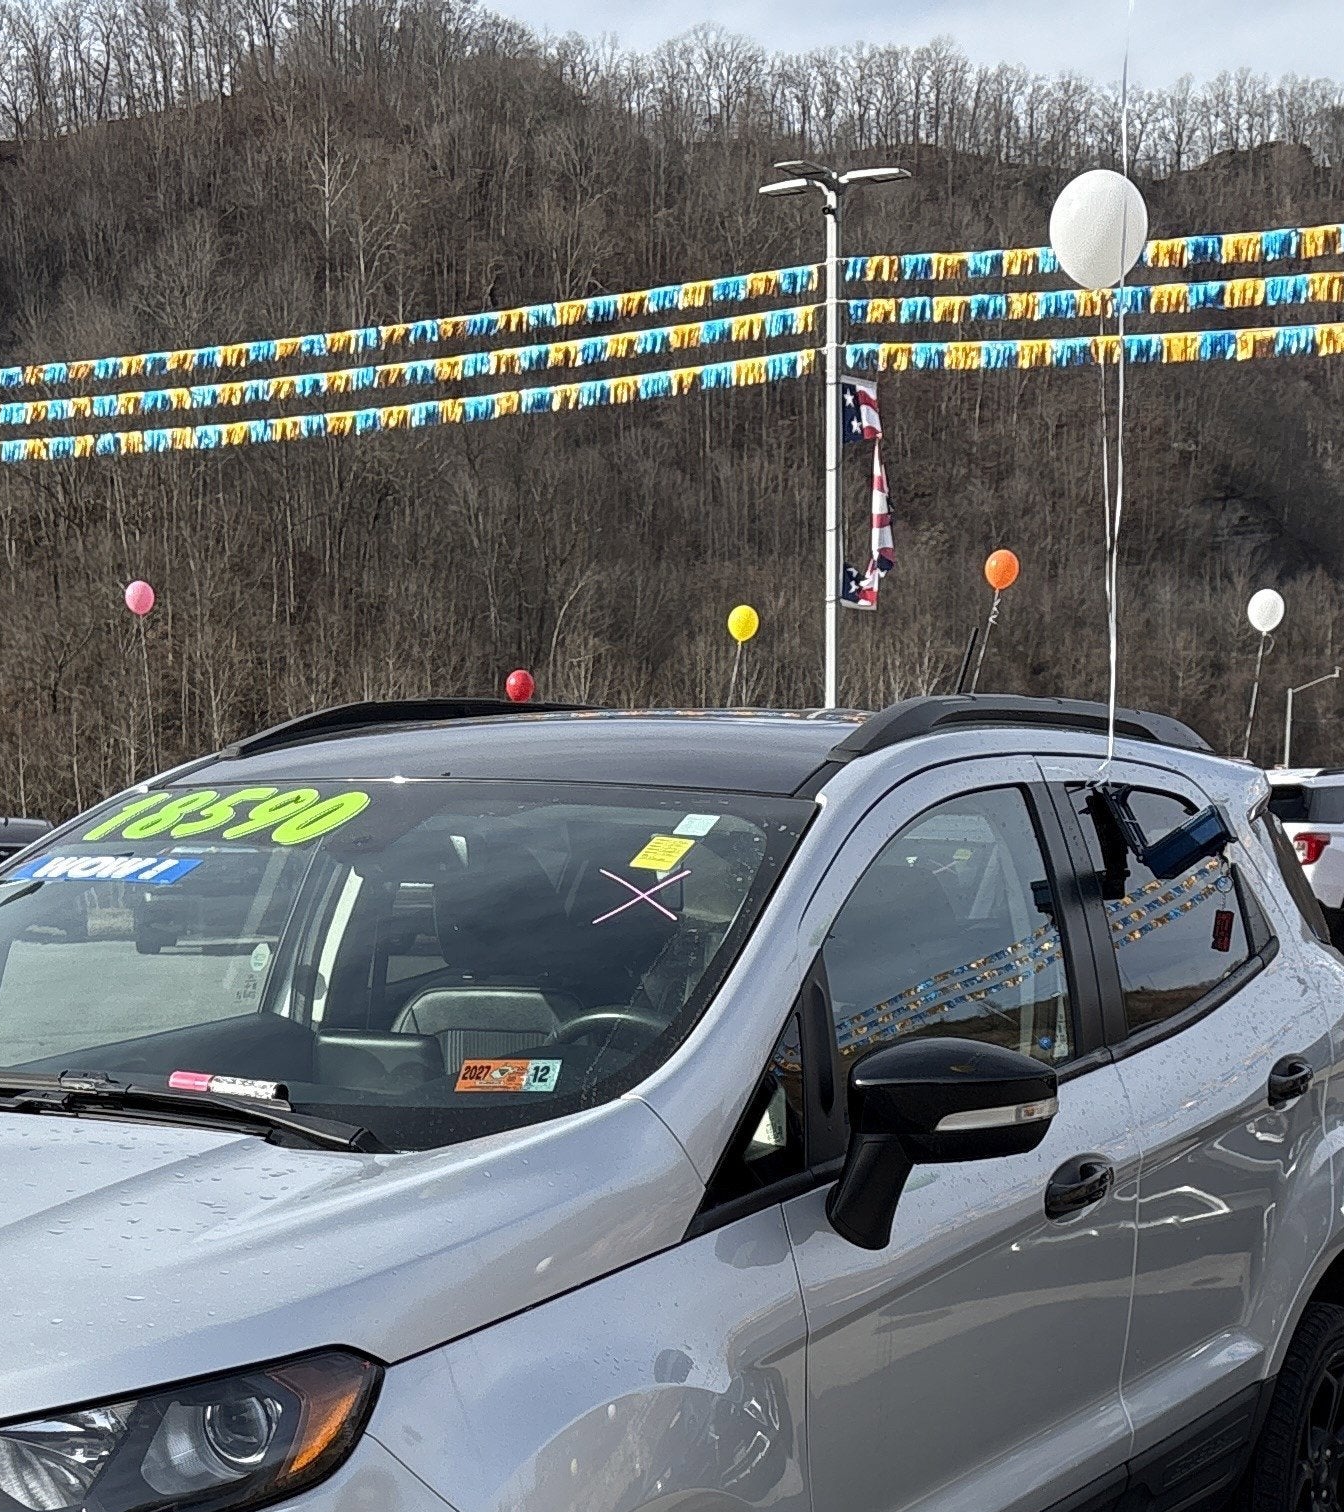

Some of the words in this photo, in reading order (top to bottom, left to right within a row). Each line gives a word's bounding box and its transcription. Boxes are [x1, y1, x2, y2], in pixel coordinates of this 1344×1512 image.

[82, 787, 371, 846] 18590
[461, 1064, 491, 1081] 2027
[532, 1065, 551, 1083] 12
